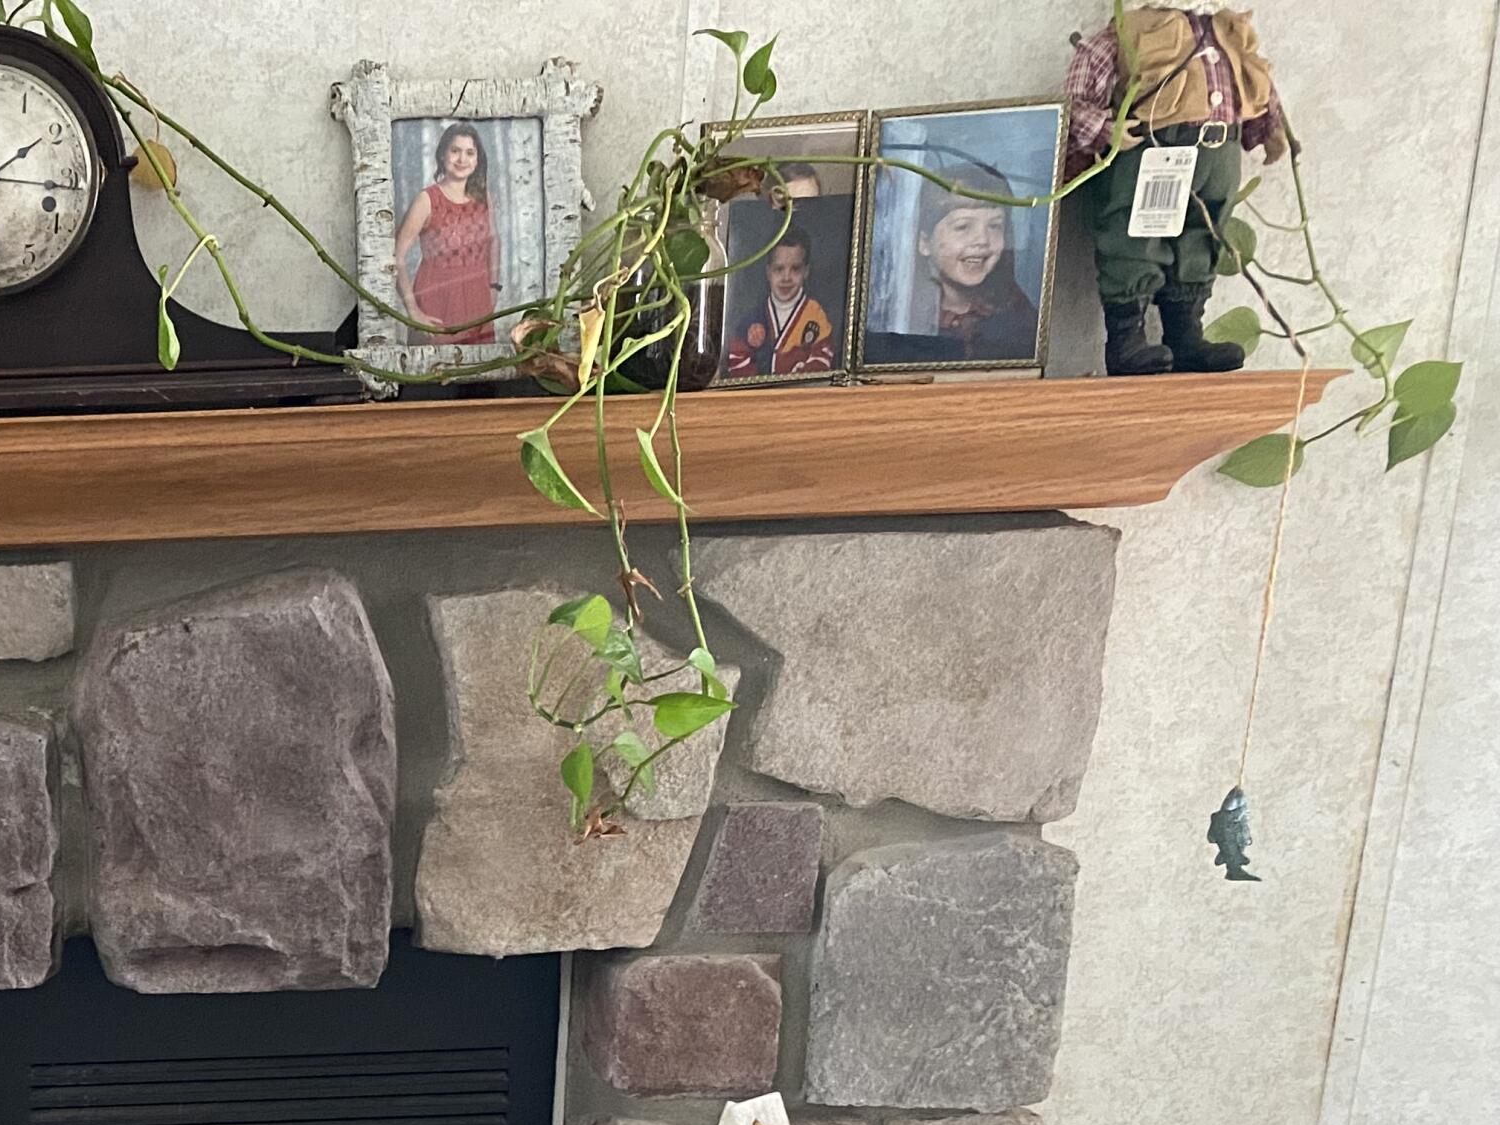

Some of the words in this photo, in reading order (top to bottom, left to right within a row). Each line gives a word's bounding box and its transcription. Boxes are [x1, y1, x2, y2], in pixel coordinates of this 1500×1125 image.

[21, 92, 28, 114] 1
[48, 122, 63, 145] 2
[22, 243, 36, 265] 5
